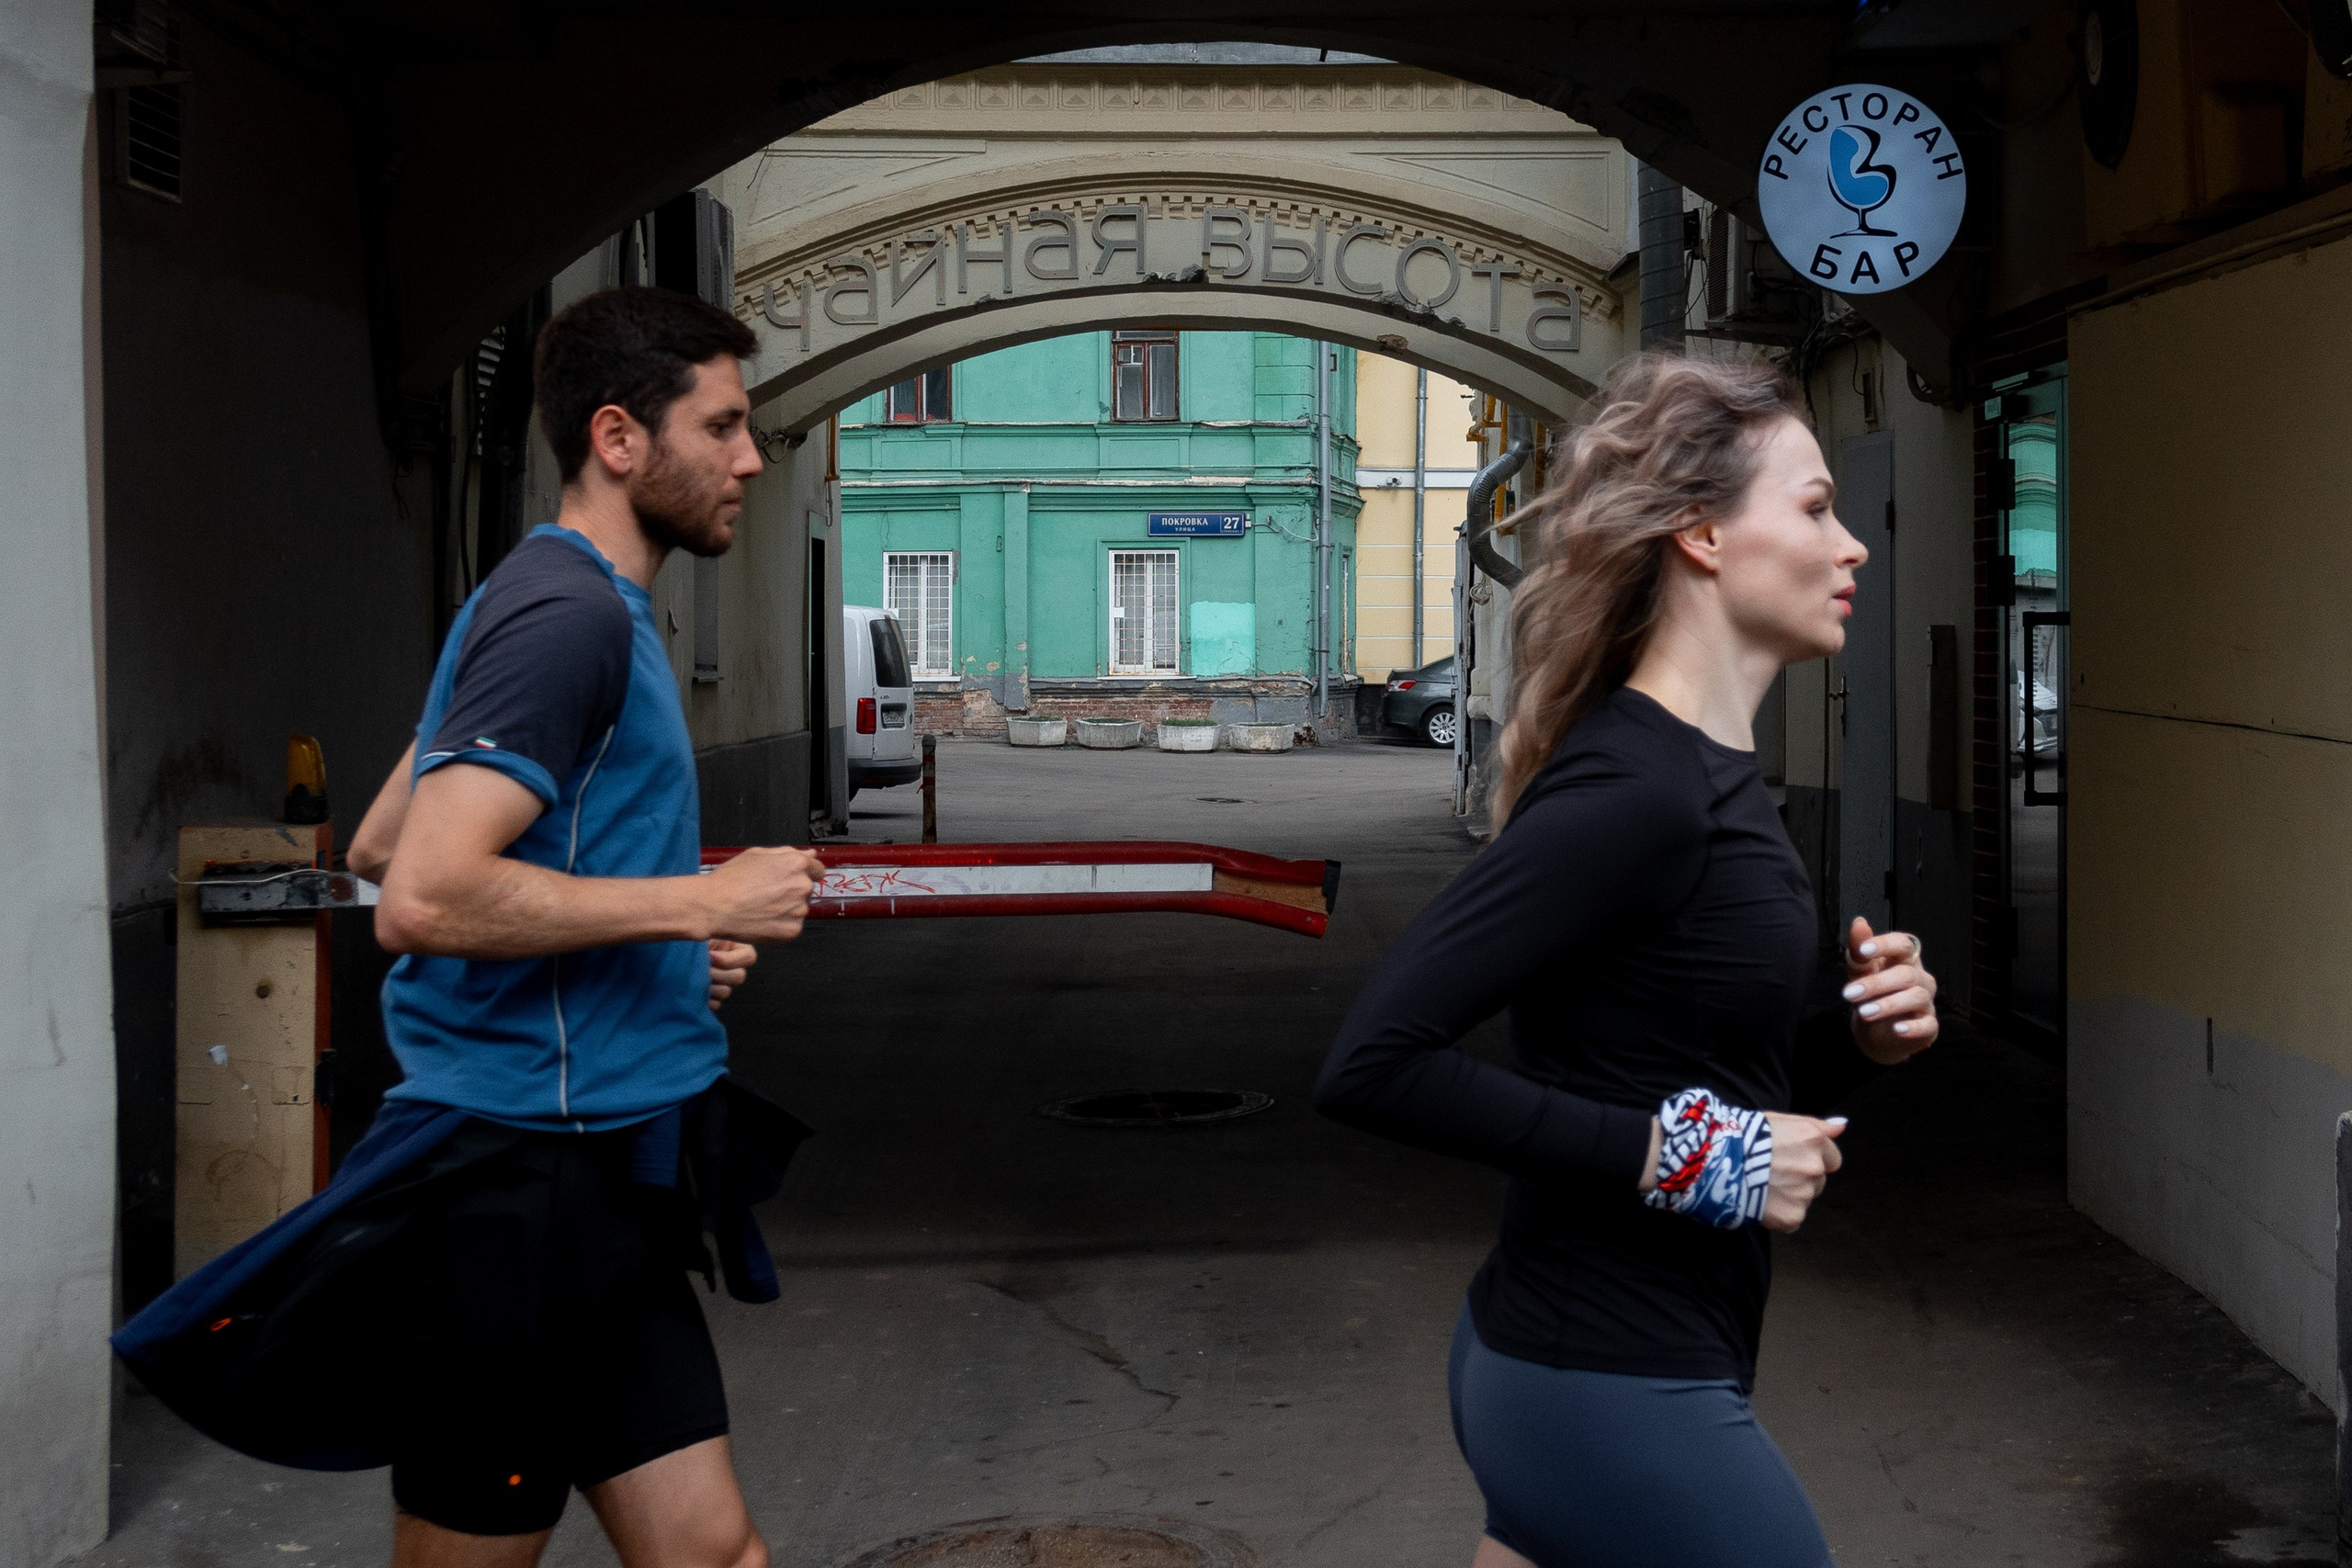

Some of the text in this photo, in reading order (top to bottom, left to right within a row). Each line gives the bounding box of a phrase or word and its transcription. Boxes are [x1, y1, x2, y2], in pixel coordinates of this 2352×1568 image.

[1763, 92, 1963, 180] РЕСТОРАН
[1809, 241, 1919, 285] БАР
[1161, 517, 1209, 526] ПОКРОВКА
[1223, 516, 1240, 529] 27
